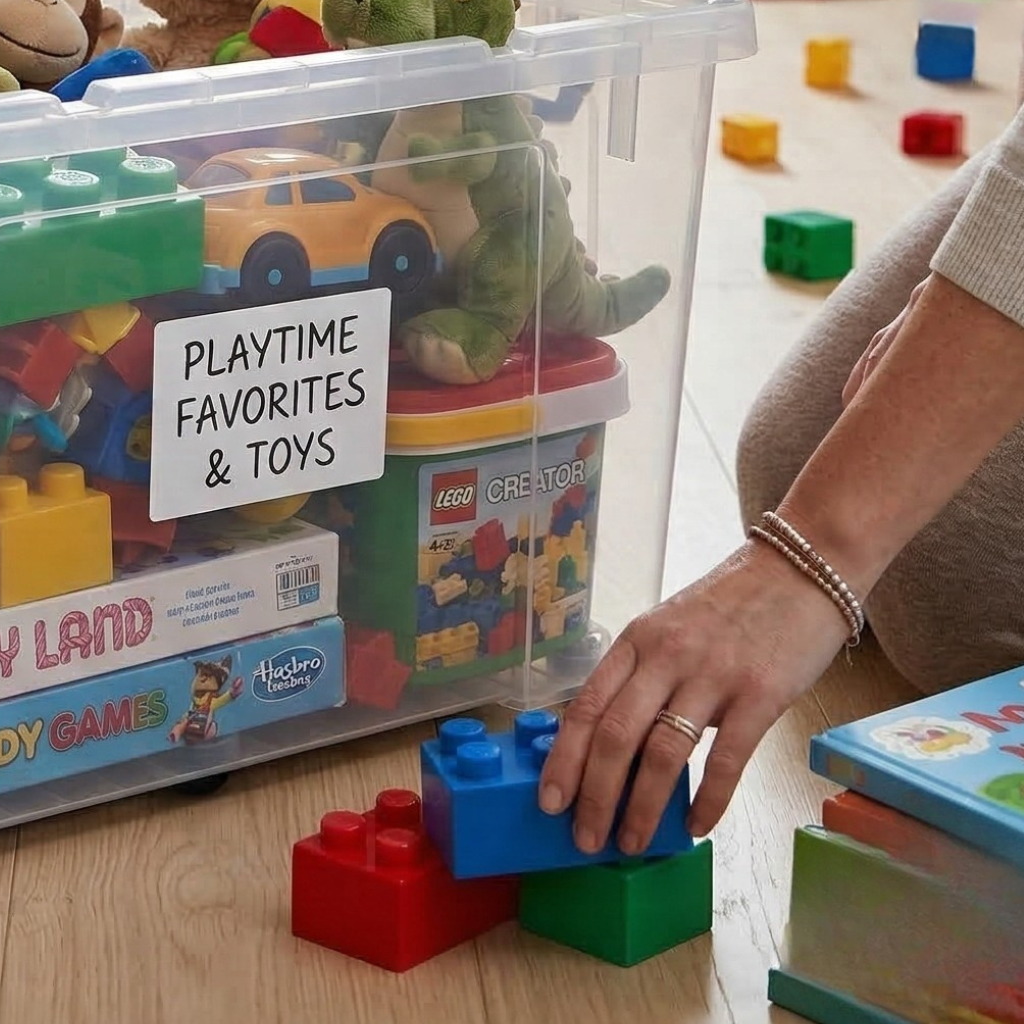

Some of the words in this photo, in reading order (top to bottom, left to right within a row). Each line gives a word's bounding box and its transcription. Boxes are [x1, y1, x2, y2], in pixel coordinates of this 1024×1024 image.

[184, 314, 359, 381] PLAYTIME
[176, 367, 366, 438] FAVORITES
[205, 448, 232, 488] &
[246, 427, 336, 479] TOYS
[433, 484, 475, 510] LEGO
[35, 597, 154, 670] LAND
[252, 655, 321, 683] Hasbro
[48, 688, 169, 752] GAMES
